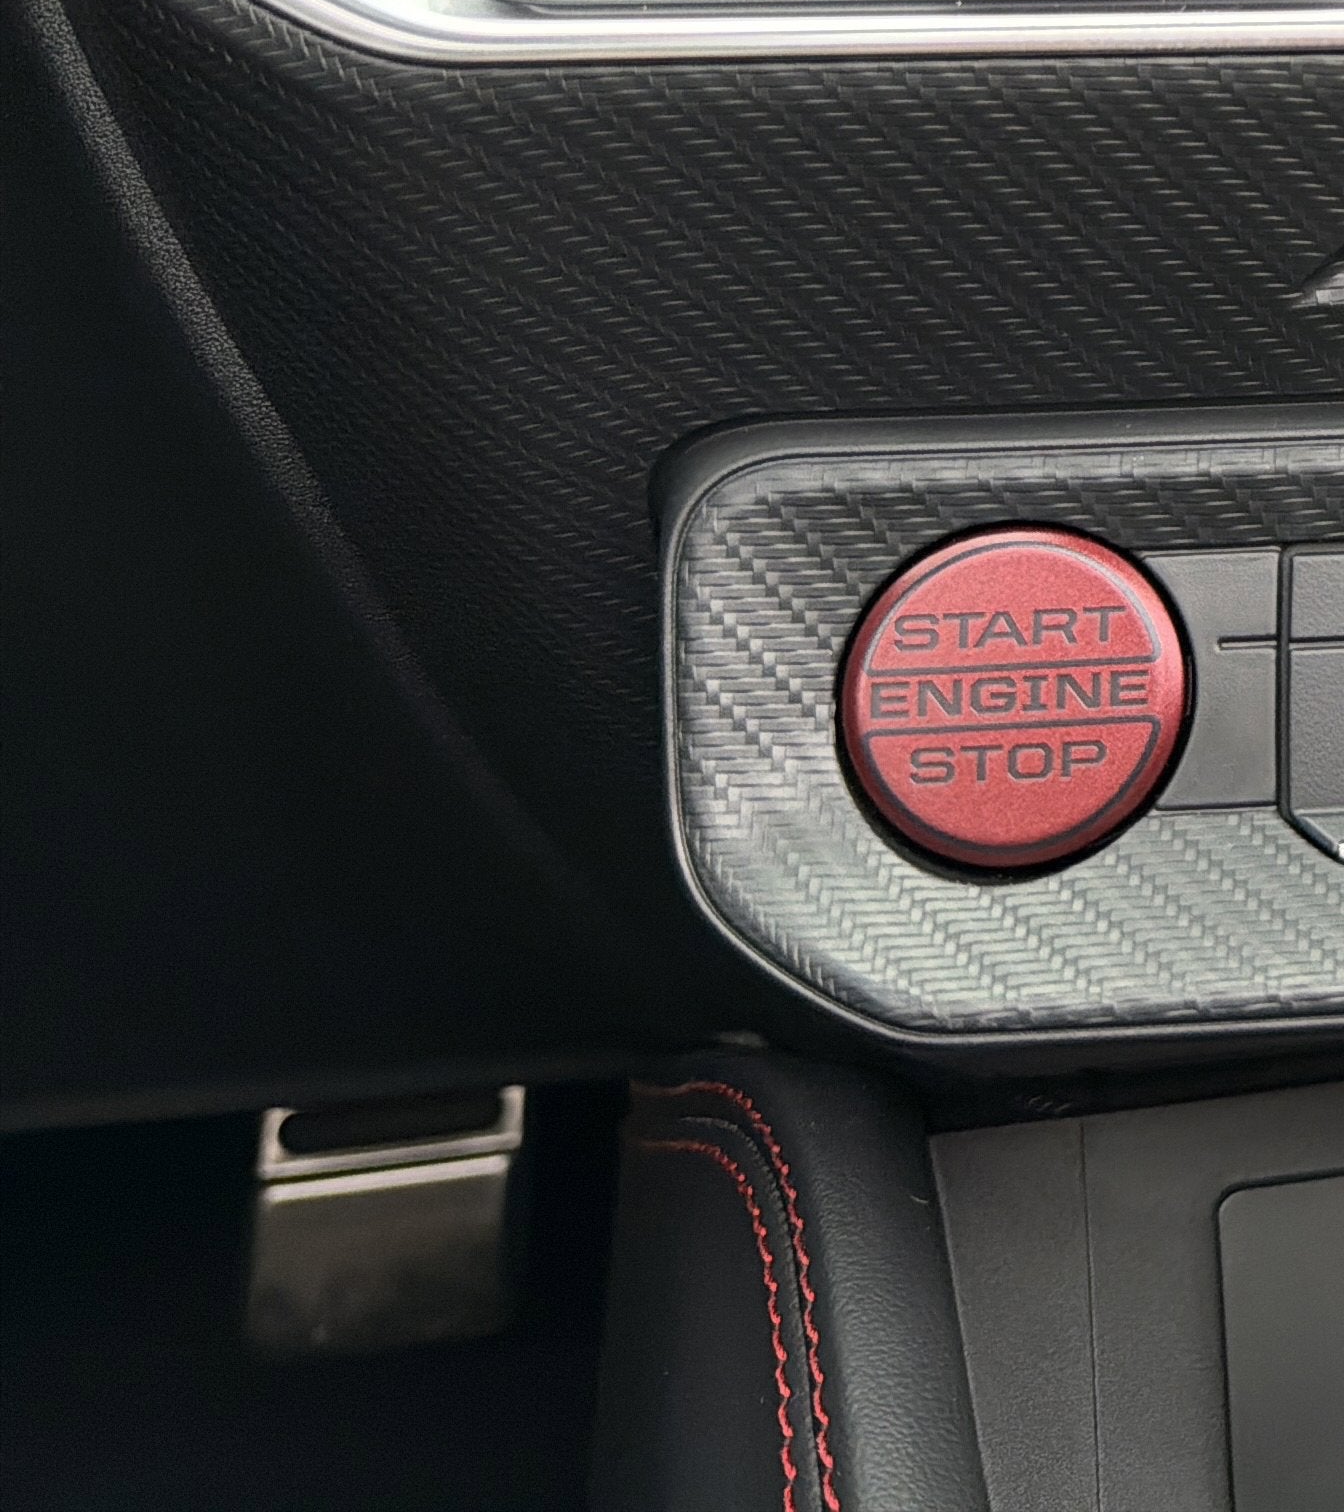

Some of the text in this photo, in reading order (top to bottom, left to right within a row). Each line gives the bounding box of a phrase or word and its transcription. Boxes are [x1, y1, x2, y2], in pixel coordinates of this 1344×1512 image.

[893, 605, 1127, 655] START
[870, 671, 1151, 721] ENGINE
[908, 740, 1108, 785] STOP
